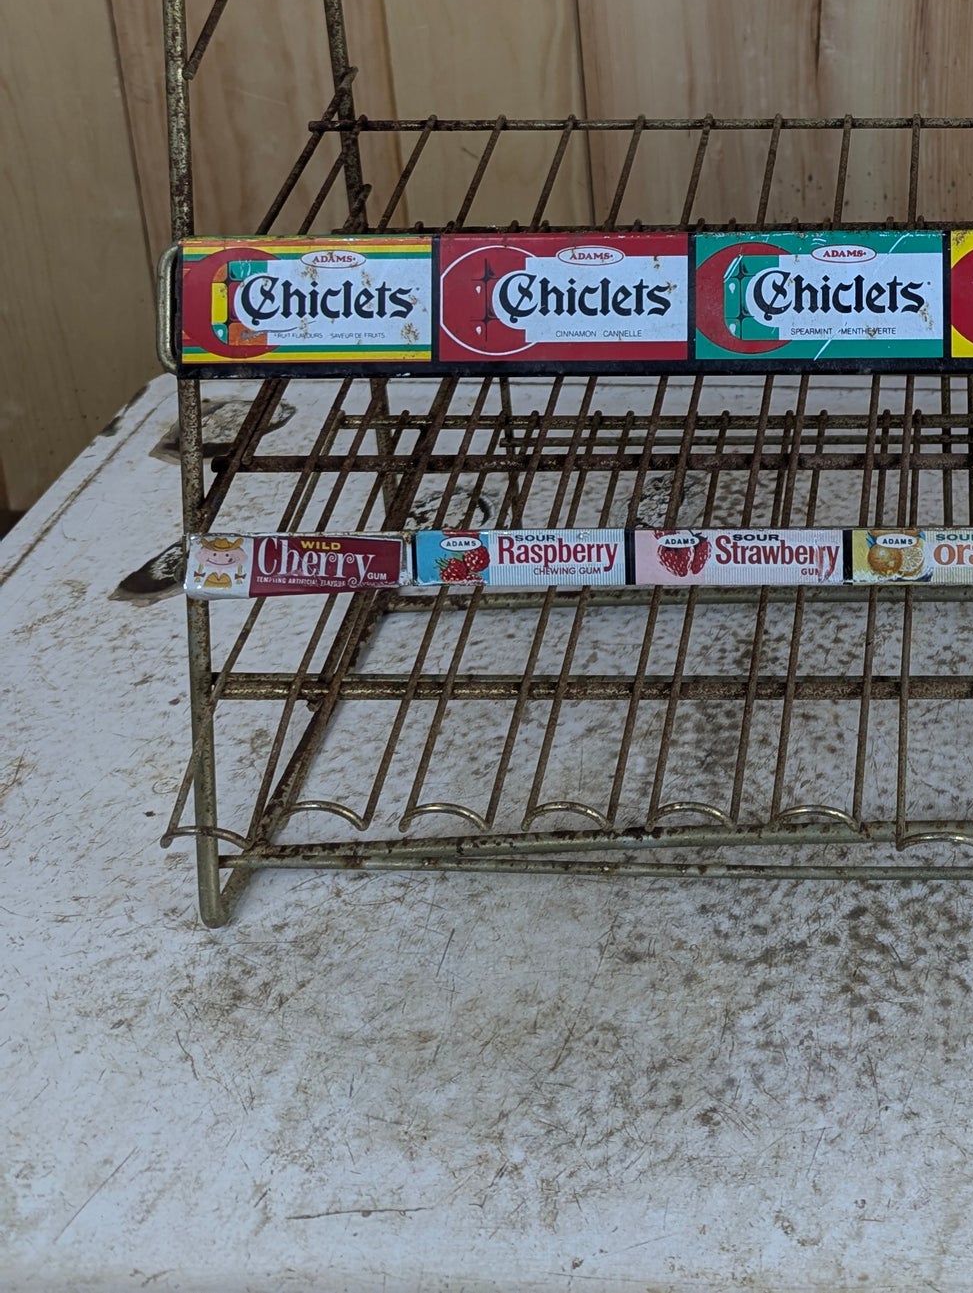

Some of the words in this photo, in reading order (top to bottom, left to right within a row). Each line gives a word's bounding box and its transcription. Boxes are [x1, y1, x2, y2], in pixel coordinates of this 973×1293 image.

[570, 252, 611, 261] ADAMS
[823, 249, 864, 258] ADAMS
[311, 254, 353, 264] ADAMS
[241, 275, 415, 325] Chiclets
[498, 273, 672, 324] Chiclets
[753, 270, 925, 321] Chiclets
[555, 329, 597, 338] CINNAMON
[602, 329, 642, 338] CANNELLE
[790, 327, 832, 336] SPEARMINT
[515, 534, 556, 542] SOUR
[732, 534, 780, 542] SOUR
[301, 540, 342, 550] WILD
[498, 536, 618, 572] Raspberry
[715, 535, 840, 581] Strawberry
[258, 537, 377, 587] Cherry
[533, 567, 577, 576] CHEWING
[579, 567, 601, 575] GUM
[367, 572, 387, 581] GUM
